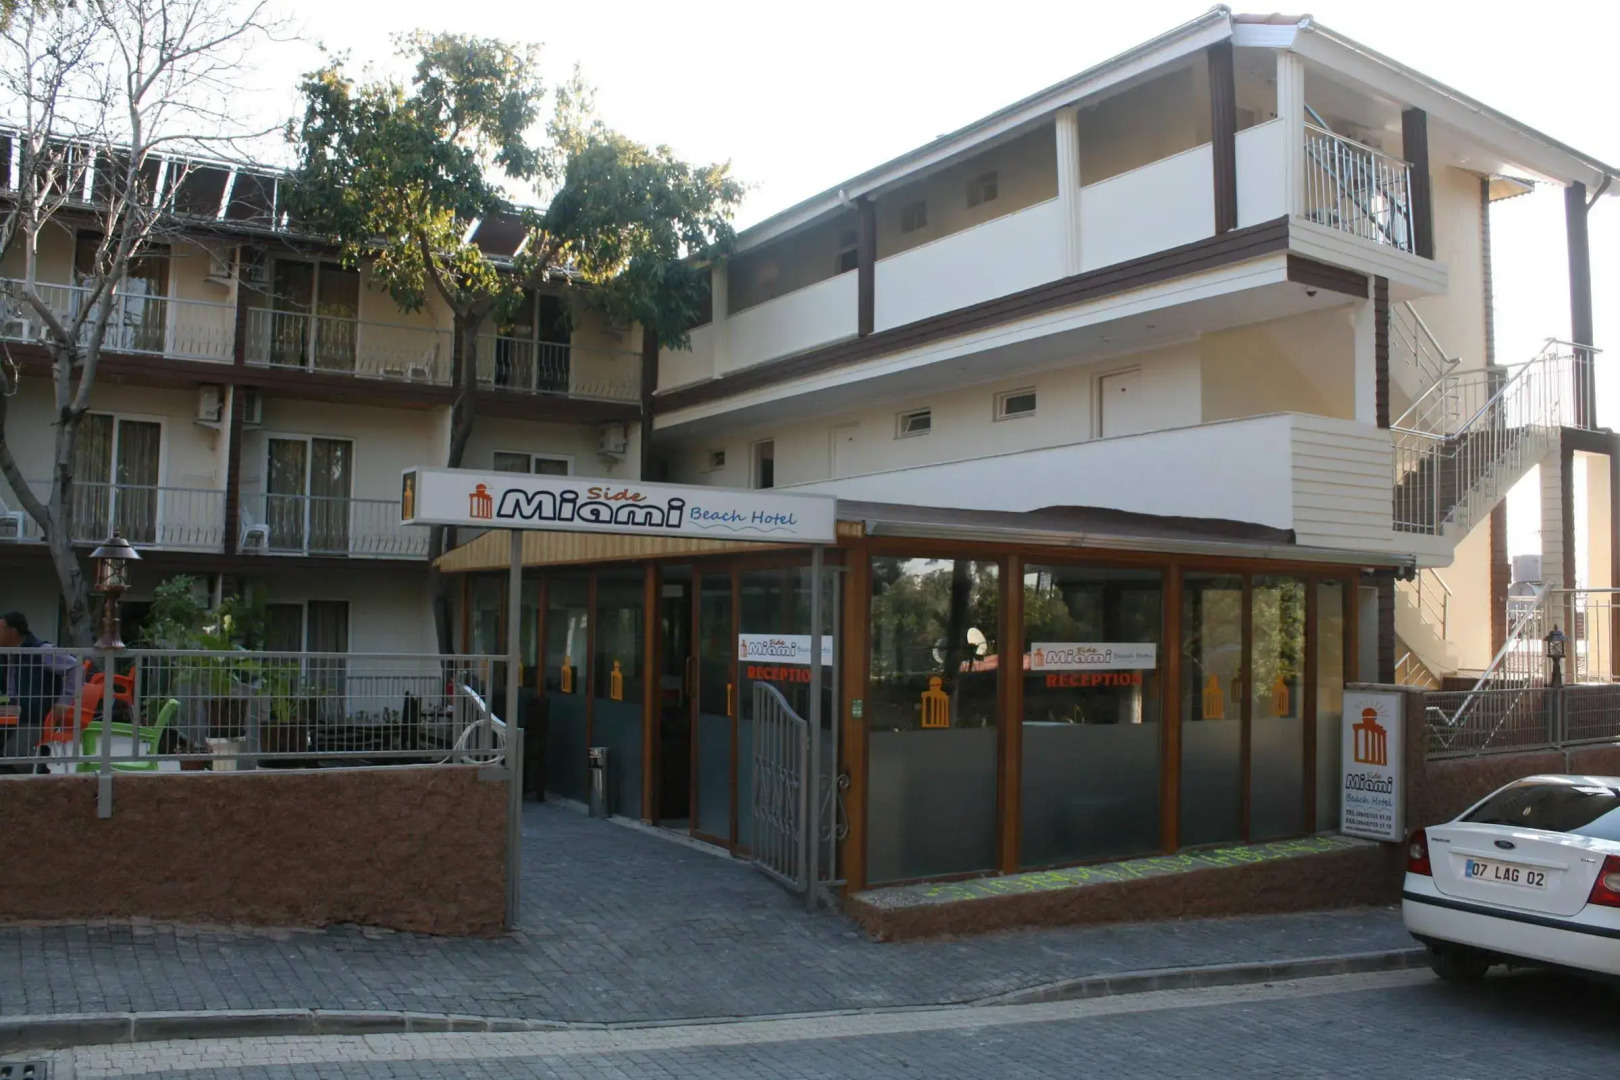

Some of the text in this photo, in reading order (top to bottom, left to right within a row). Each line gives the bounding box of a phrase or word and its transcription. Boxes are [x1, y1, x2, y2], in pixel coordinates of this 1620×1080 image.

[587, 486, 647, 502] Side
[496, 489, 797, 528] Miami Beach Hotel
[748, 641, 796, 656] Miami
[1045, 650, 1112, 664] Miami
[747, 665, 812, 683] RECEPTIO
[1046, 673, 1142, 687] RECEPTION
[1345, 773, 1393, 794] Miami
[1346, 793, 1392, 807] Beach Hotel
[1472, 863, 1544, 886] 07 LAG 02
